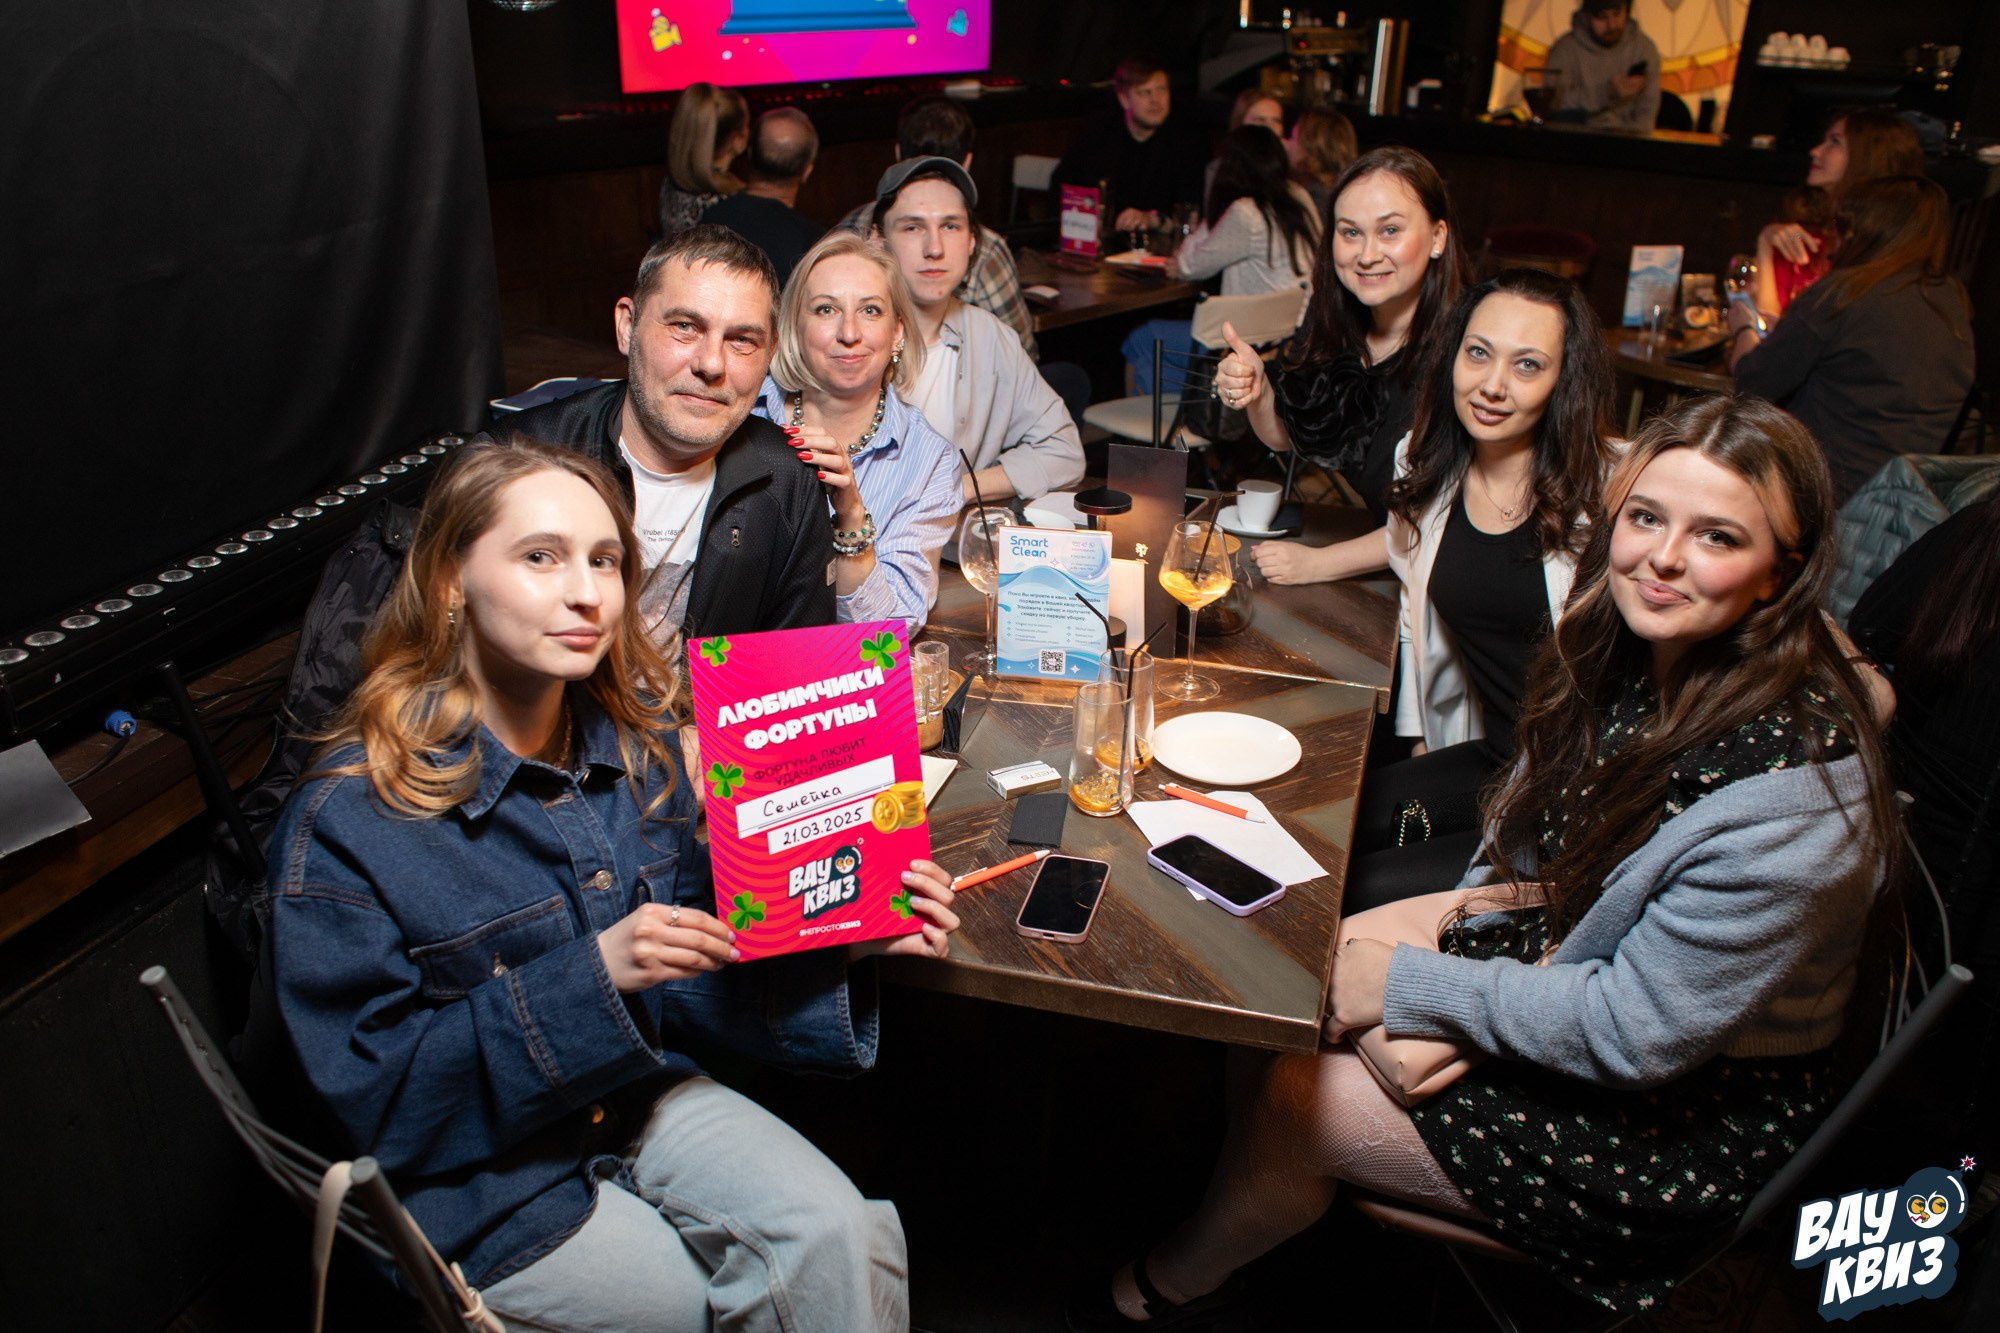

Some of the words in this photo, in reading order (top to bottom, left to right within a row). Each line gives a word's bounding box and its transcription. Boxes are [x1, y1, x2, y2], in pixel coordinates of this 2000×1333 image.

[1010, 536, 1048, 547] Smart
[1012, 546, 1047, 558] Clean
[717, 666, 885, 728] ЛЮБИМЧИКИ
[743, 698, 878, 750] ФОРТУНЫ
[754, 754, 817, 781] ФОРТУНА
[821, 737, 867, 759] ЛЮБИТ
[774, 754, 856, 787] УДАЧЛИВЫХ
[763, 786, 843, 817] Семейка
[783, 807, 864, 846] 21.03.2025
[788, 857, 832, 897] ВАУ
[803, 875, 856, 915] КВИЗ
